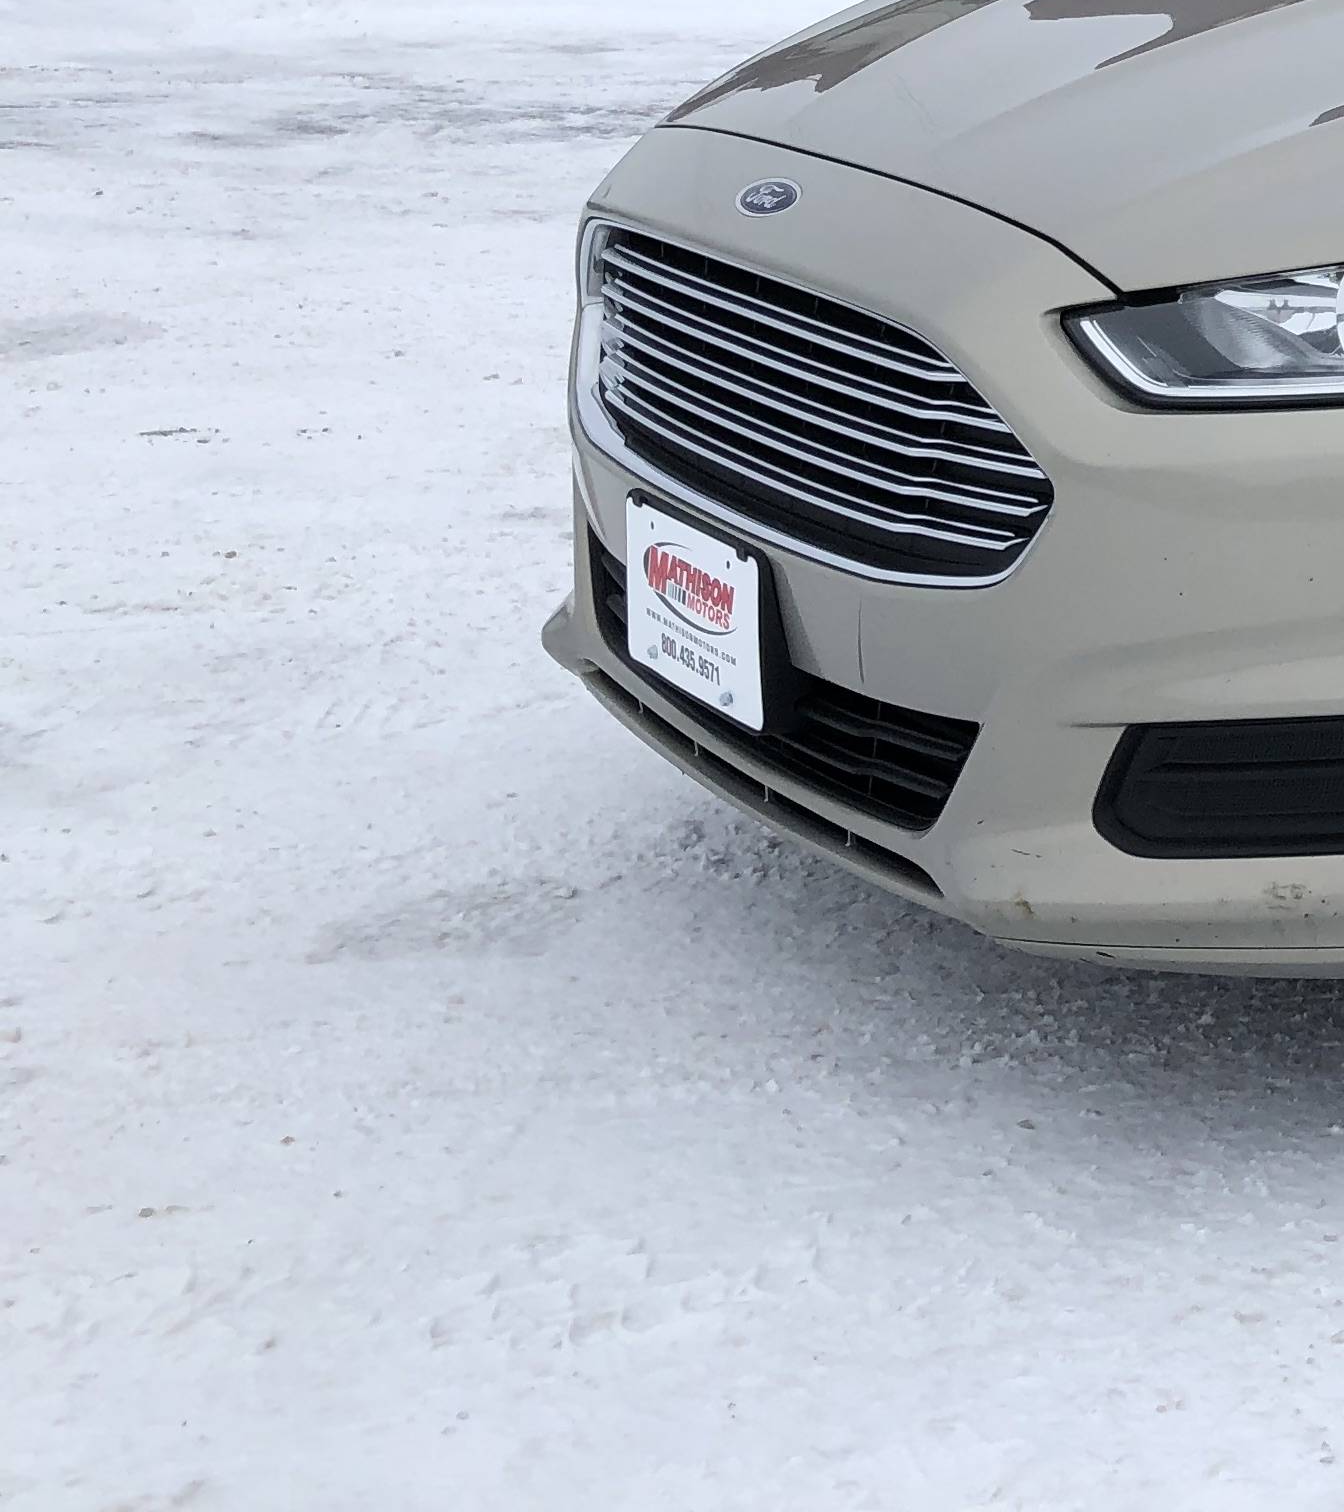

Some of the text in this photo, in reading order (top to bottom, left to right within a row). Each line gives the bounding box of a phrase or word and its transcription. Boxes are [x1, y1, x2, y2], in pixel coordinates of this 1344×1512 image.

[648, 546, 734, 615] MATHISON
[686, 595, 731, 630] MOTORS
[661, 632, 721, 686] 800.435.9571
